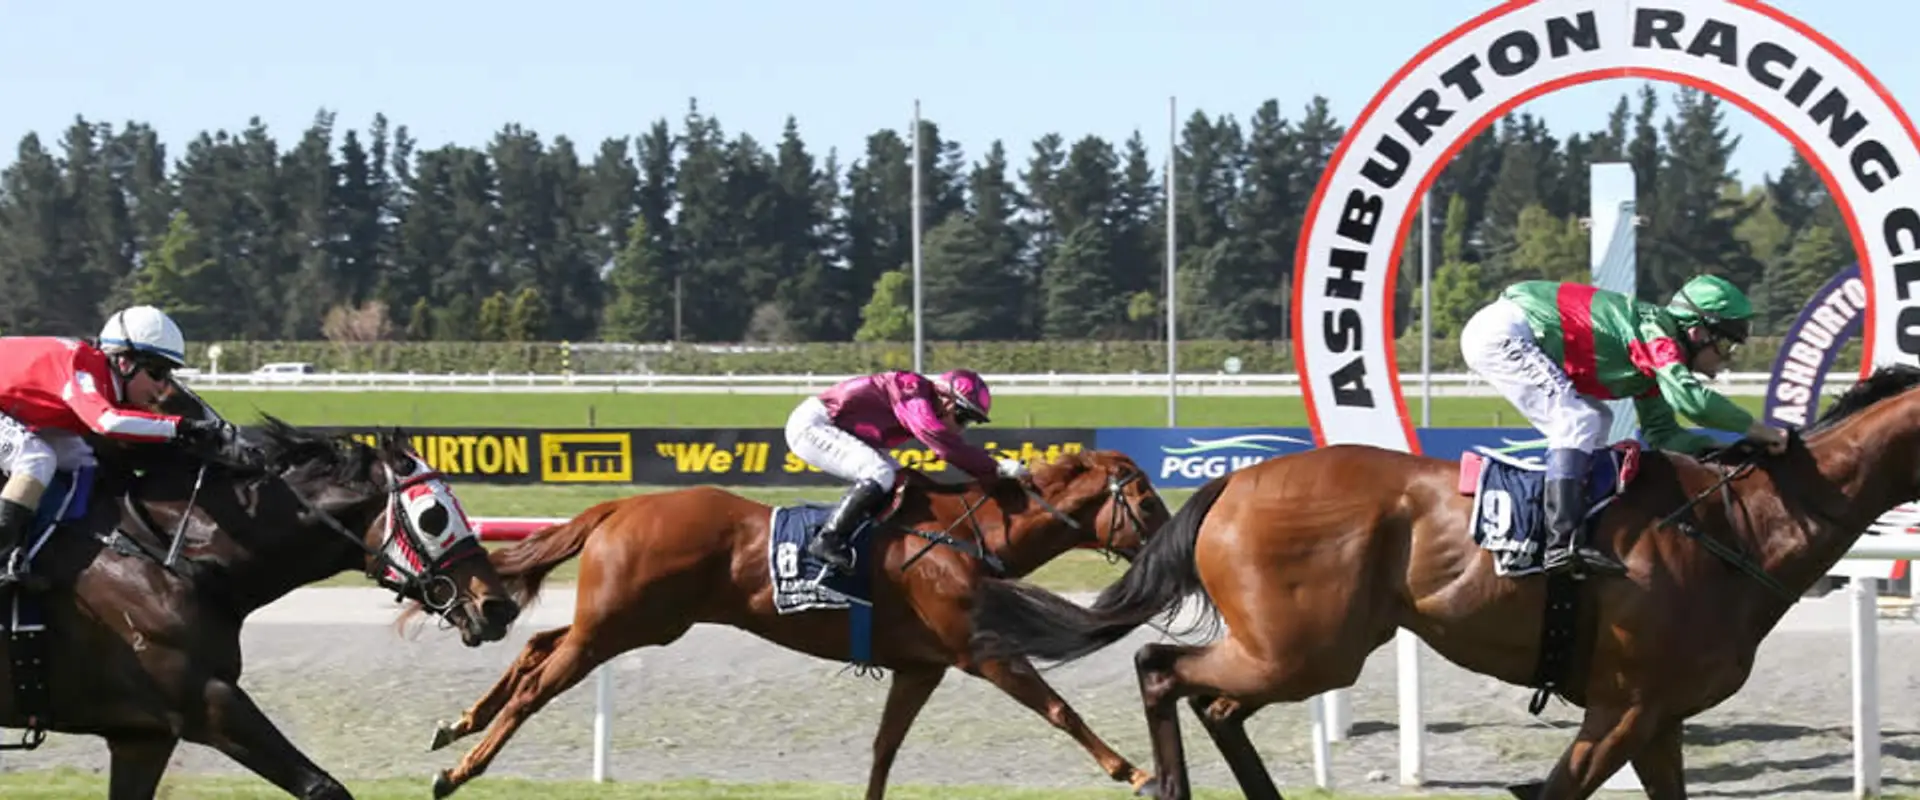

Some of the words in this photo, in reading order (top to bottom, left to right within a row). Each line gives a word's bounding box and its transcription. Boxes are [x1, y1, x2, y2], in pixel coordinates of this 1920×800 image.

[1323, 10, 1600, 409] ASHBURTON
[1633, 8, 1900, 193] RACING
[1882, 207, 1920, 357] CLU
[1772, 278, 1866, 425] ASHBURTO
[1160, 456, 1226, 479] PGG
[1482, 489, 1511, 537] 9
